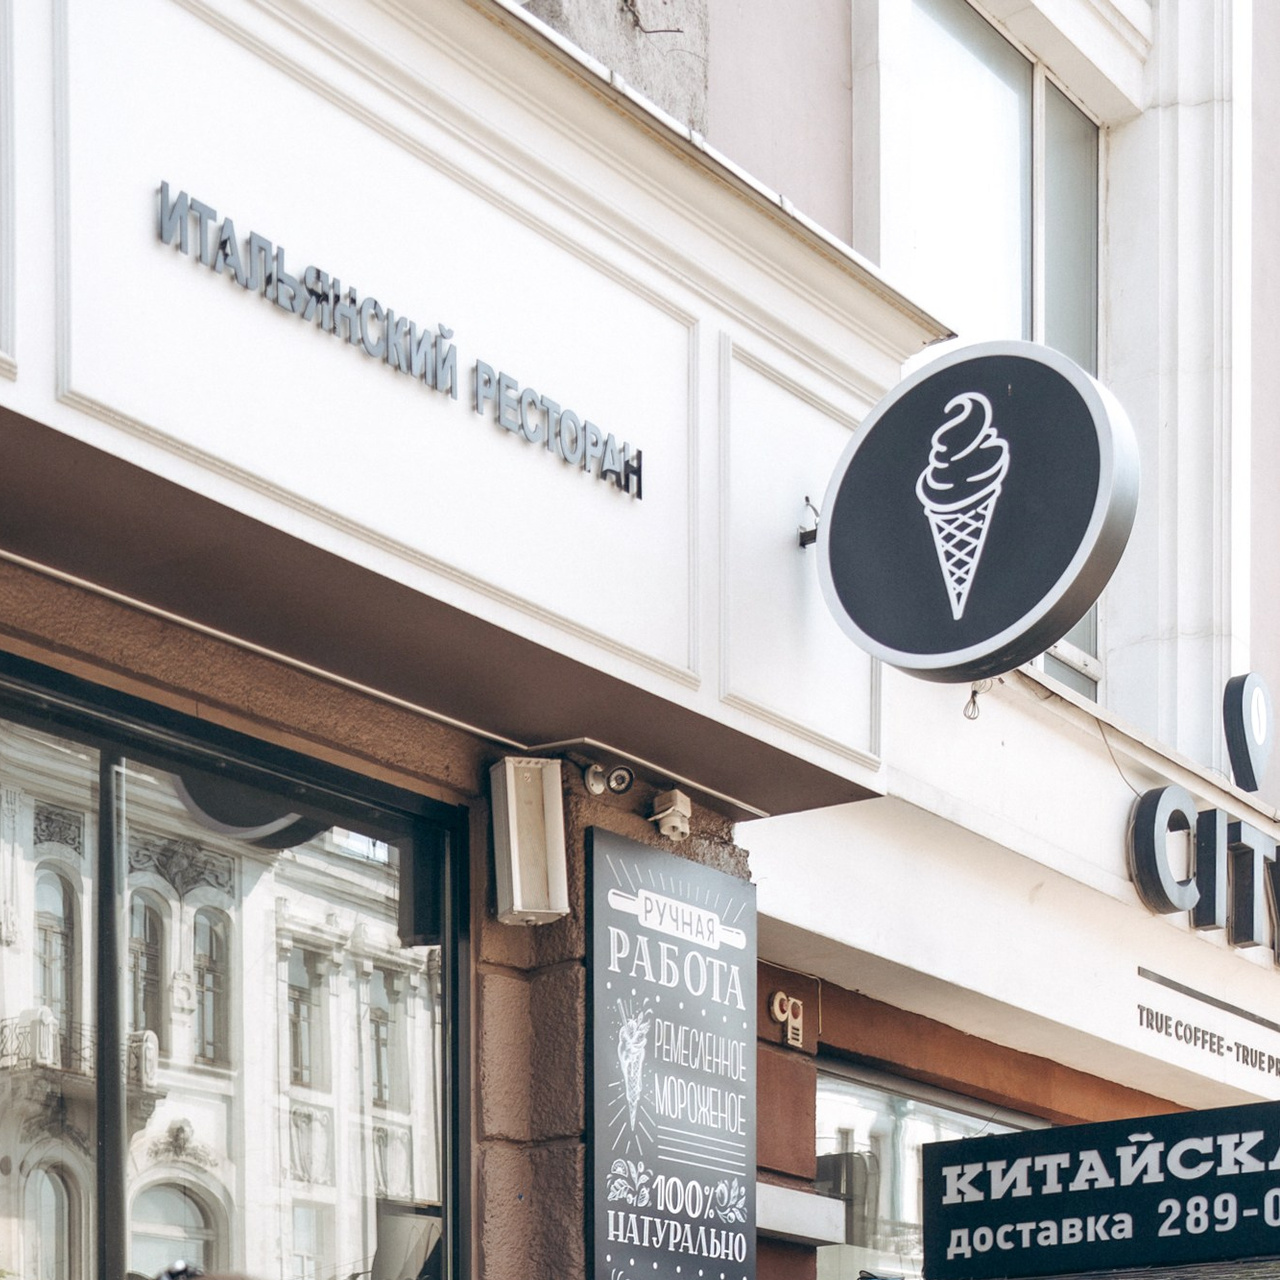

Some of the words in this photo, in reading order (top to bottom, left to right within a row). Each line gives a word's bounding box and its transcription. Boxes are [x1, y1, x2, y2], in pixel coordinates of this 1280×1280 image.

[155, 179, 458, 401] ИТАЛЬЯНСКИЙ
[473, 357, 644, 501] РЕСТОРАН
[1130, 784, 1280, 968] CIT
[643, 895, 716, 945] РУЧНАЯ
[607, 926, 747, 1011] РАБОТА
[655, 1017, 747, 1083] РЕМЕСЛЕННОЕ
[1137, 1004, 1173, 1037] TRUE
[1174, 1020, 1225, 1057] COFFEE
[1234, 1041, 1266, 1072] TRUE
[655, 1073, 747, 1136] МОРОЖЕНОЕ
[652, 1175, 716, 1219] 100%
[942, 1130, 1280, 1205] КИТАЙСК
[607, 1210, 747, 1263] НАТУРАЛЬНО
[946, 1212, 1133, 1260] доставка
